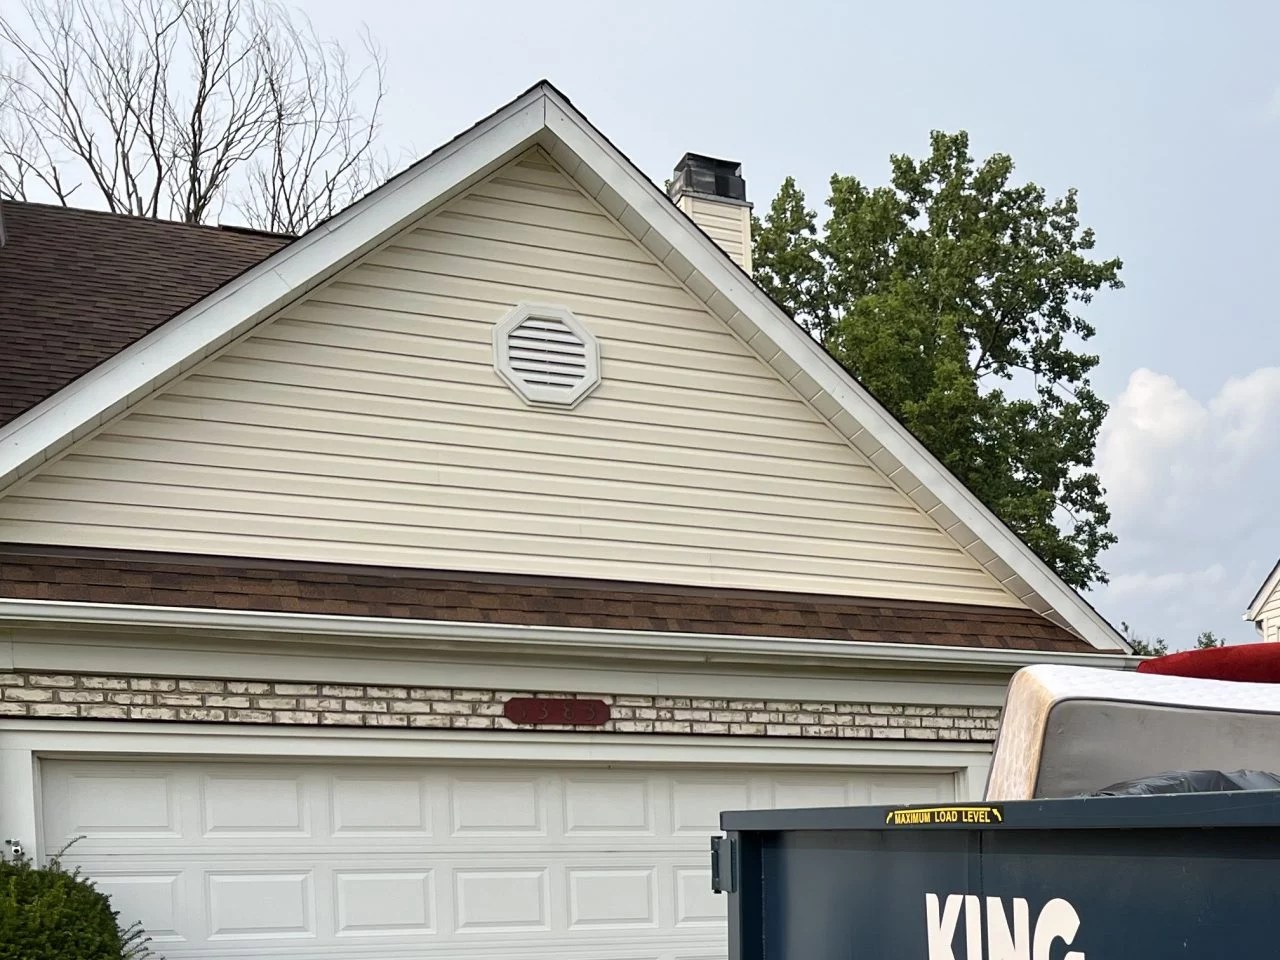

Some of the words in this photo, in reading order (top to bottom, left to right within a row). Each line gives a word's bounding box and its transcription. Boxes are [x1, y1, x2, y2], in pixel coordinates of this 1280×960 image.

[894, 812, 931, 824] MAXIMUM
[934, 811, 958, 823] LOAD
[962, 811, 991, 823] LEVEL
